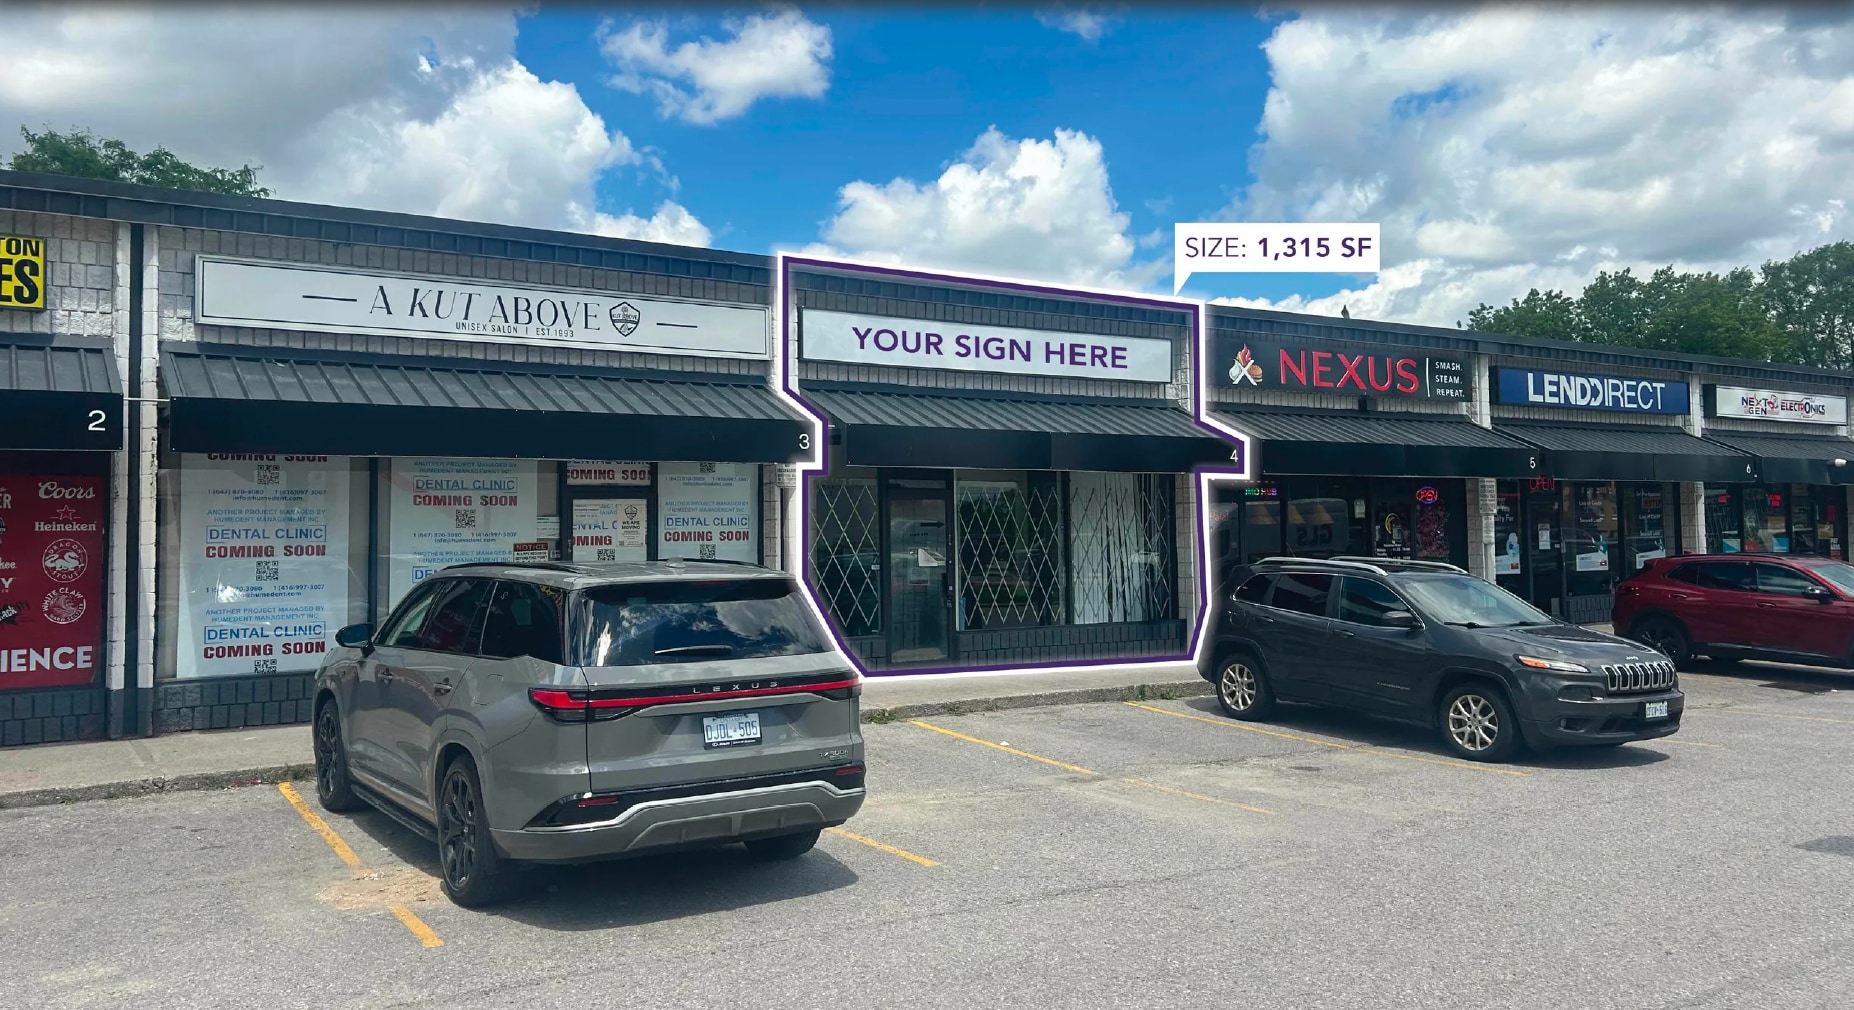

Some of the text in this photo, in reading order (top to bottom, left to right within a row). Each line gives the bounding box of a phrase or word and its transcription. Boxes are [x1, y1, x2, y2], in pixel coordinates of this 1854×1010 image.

[0, 258, 39, 304] ES
[370, 285, 601, 331] A KUT ABOVE
[455, 322, 487, 332] UNISEX
[491, 324, 518, 334] SALON
[1279, 349, 1419, 393] NEXUS
[1435, 361, 1463, 371] SMASH.
[1435, 374, 1463, 384] STEAM.
[1436, 388, 1465, 398] REPEAT.
[1527, 372, 1666, 410] LENDDIRECT
[1741, 394, 1768, 407] NEXT
[1748, 407, 1767, 415] GEN
[1781, 401, 1825, 415] ELECTRONICS
[88, 410, 107, 432] 2
[798, 433, 810, 451] 3
[1229, 449, 1239, 463] 4
[1529, 457, 1536, 469] 5
[1746, 463, 1752, 474] 6
[38, 481, 95, 499] Coors
[416, 479, 515, 490] DENTAL CLINIC
[1529, 475, 1555, 491] OPEN
[413, 495, 517, 506] COMING SOON
[34, 521, 97, 531] Heineken
[666, 517, 748, 527] DENTAL CLINIC
[209, 528, 323, 540] DENTAL CLINIC
[664, 531, 749, 542] COMING SOON
[206, 544, 326, 558] COMING SOON
[42, 587, 83, 611] WHITE CLAW
[207, 624, 322, 640] DENTAL CLINIC
[203, 641, 326, 659] COMING SOON
[0, 646, 93, 673] IENCE
[693, 681, 778, 694] LEXUS
[738, 720, 758, 737] 505
